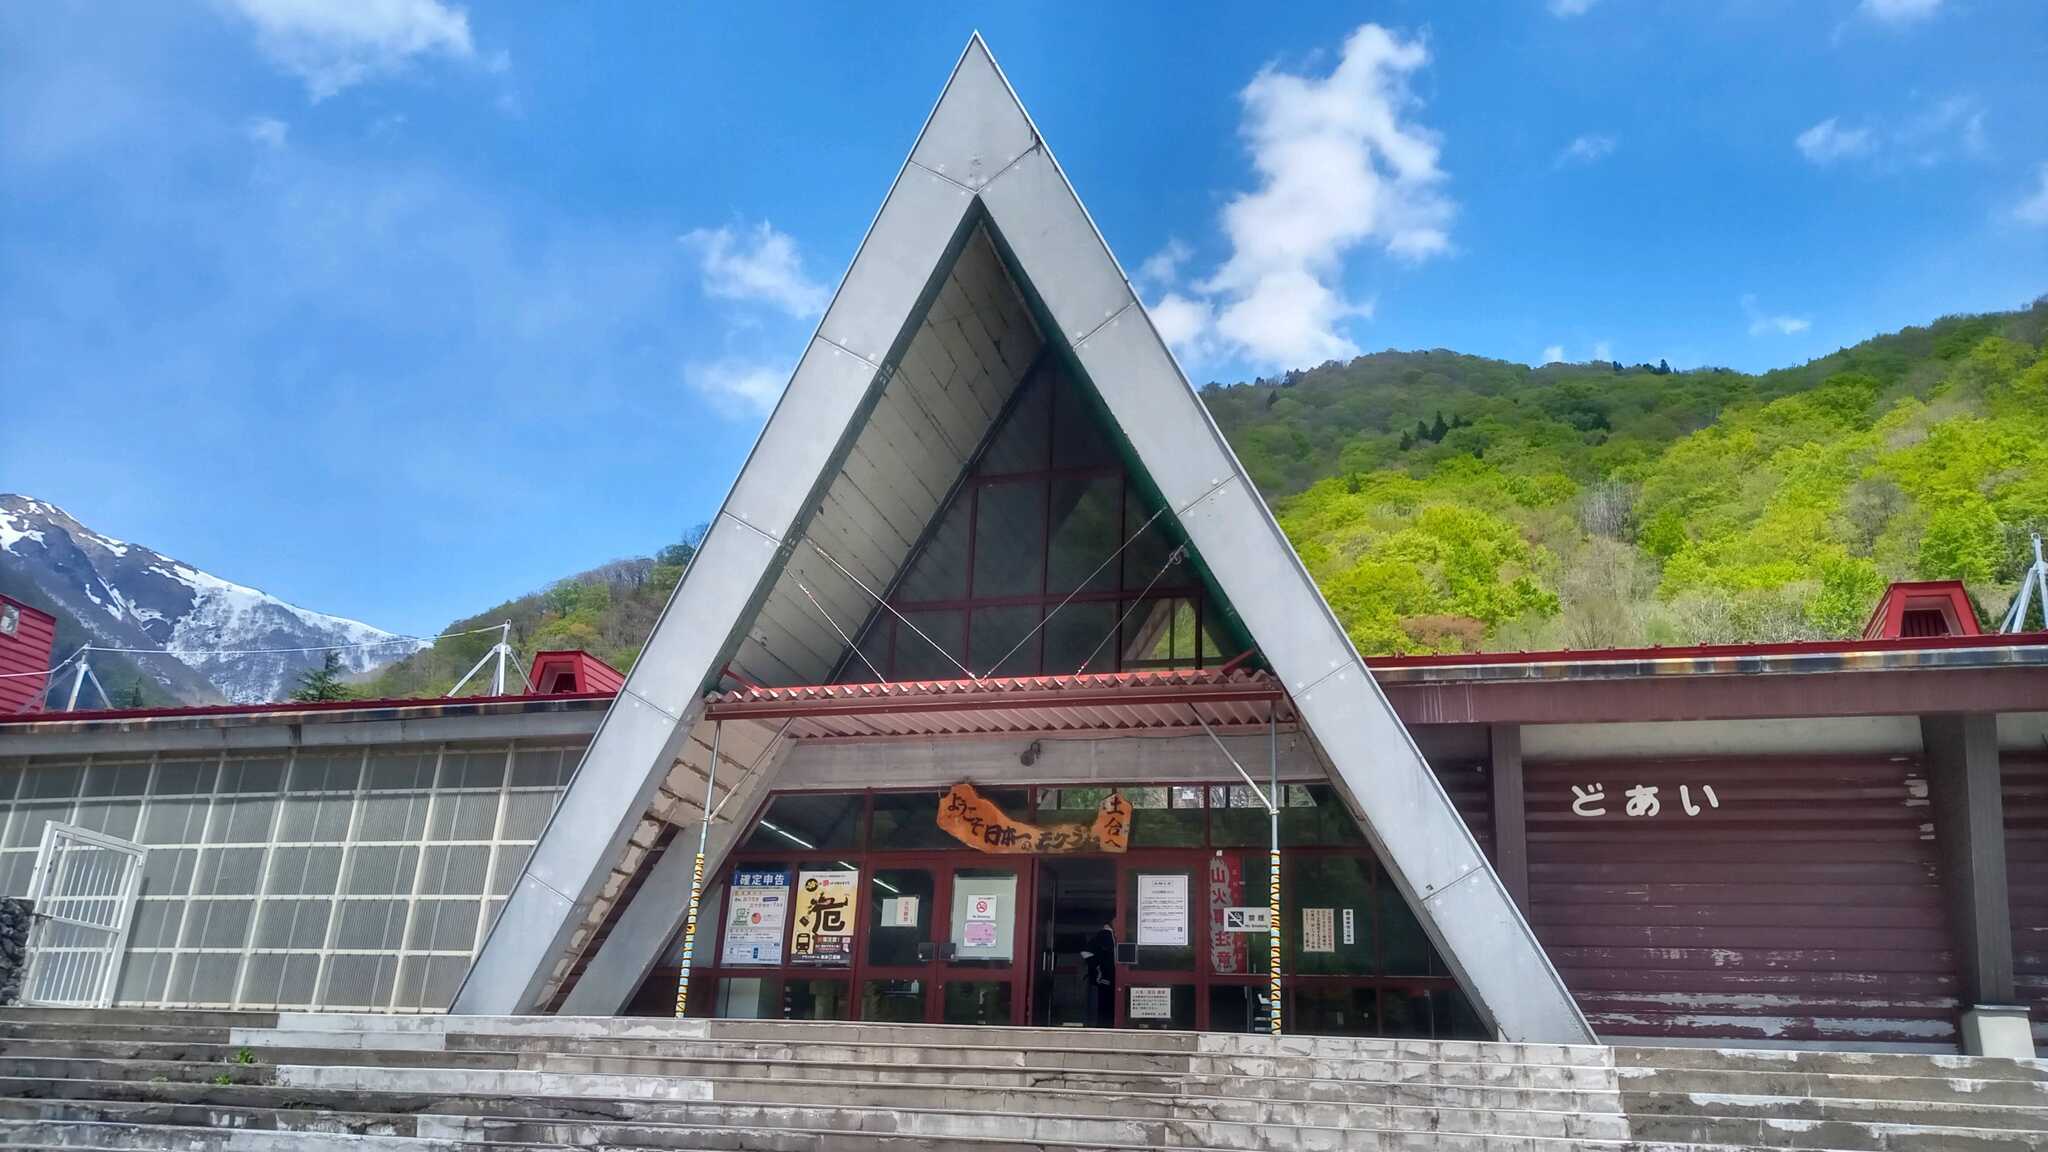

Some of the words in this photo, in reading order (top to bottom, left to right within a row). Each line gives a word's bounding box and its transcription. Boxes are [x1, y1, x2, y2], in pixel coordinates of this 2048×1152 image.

[1571, 782, 1720, 817] どあい
[1104, 797, 1125, 848] 土合へ
[739, 874, 785, 886] 確定申告
